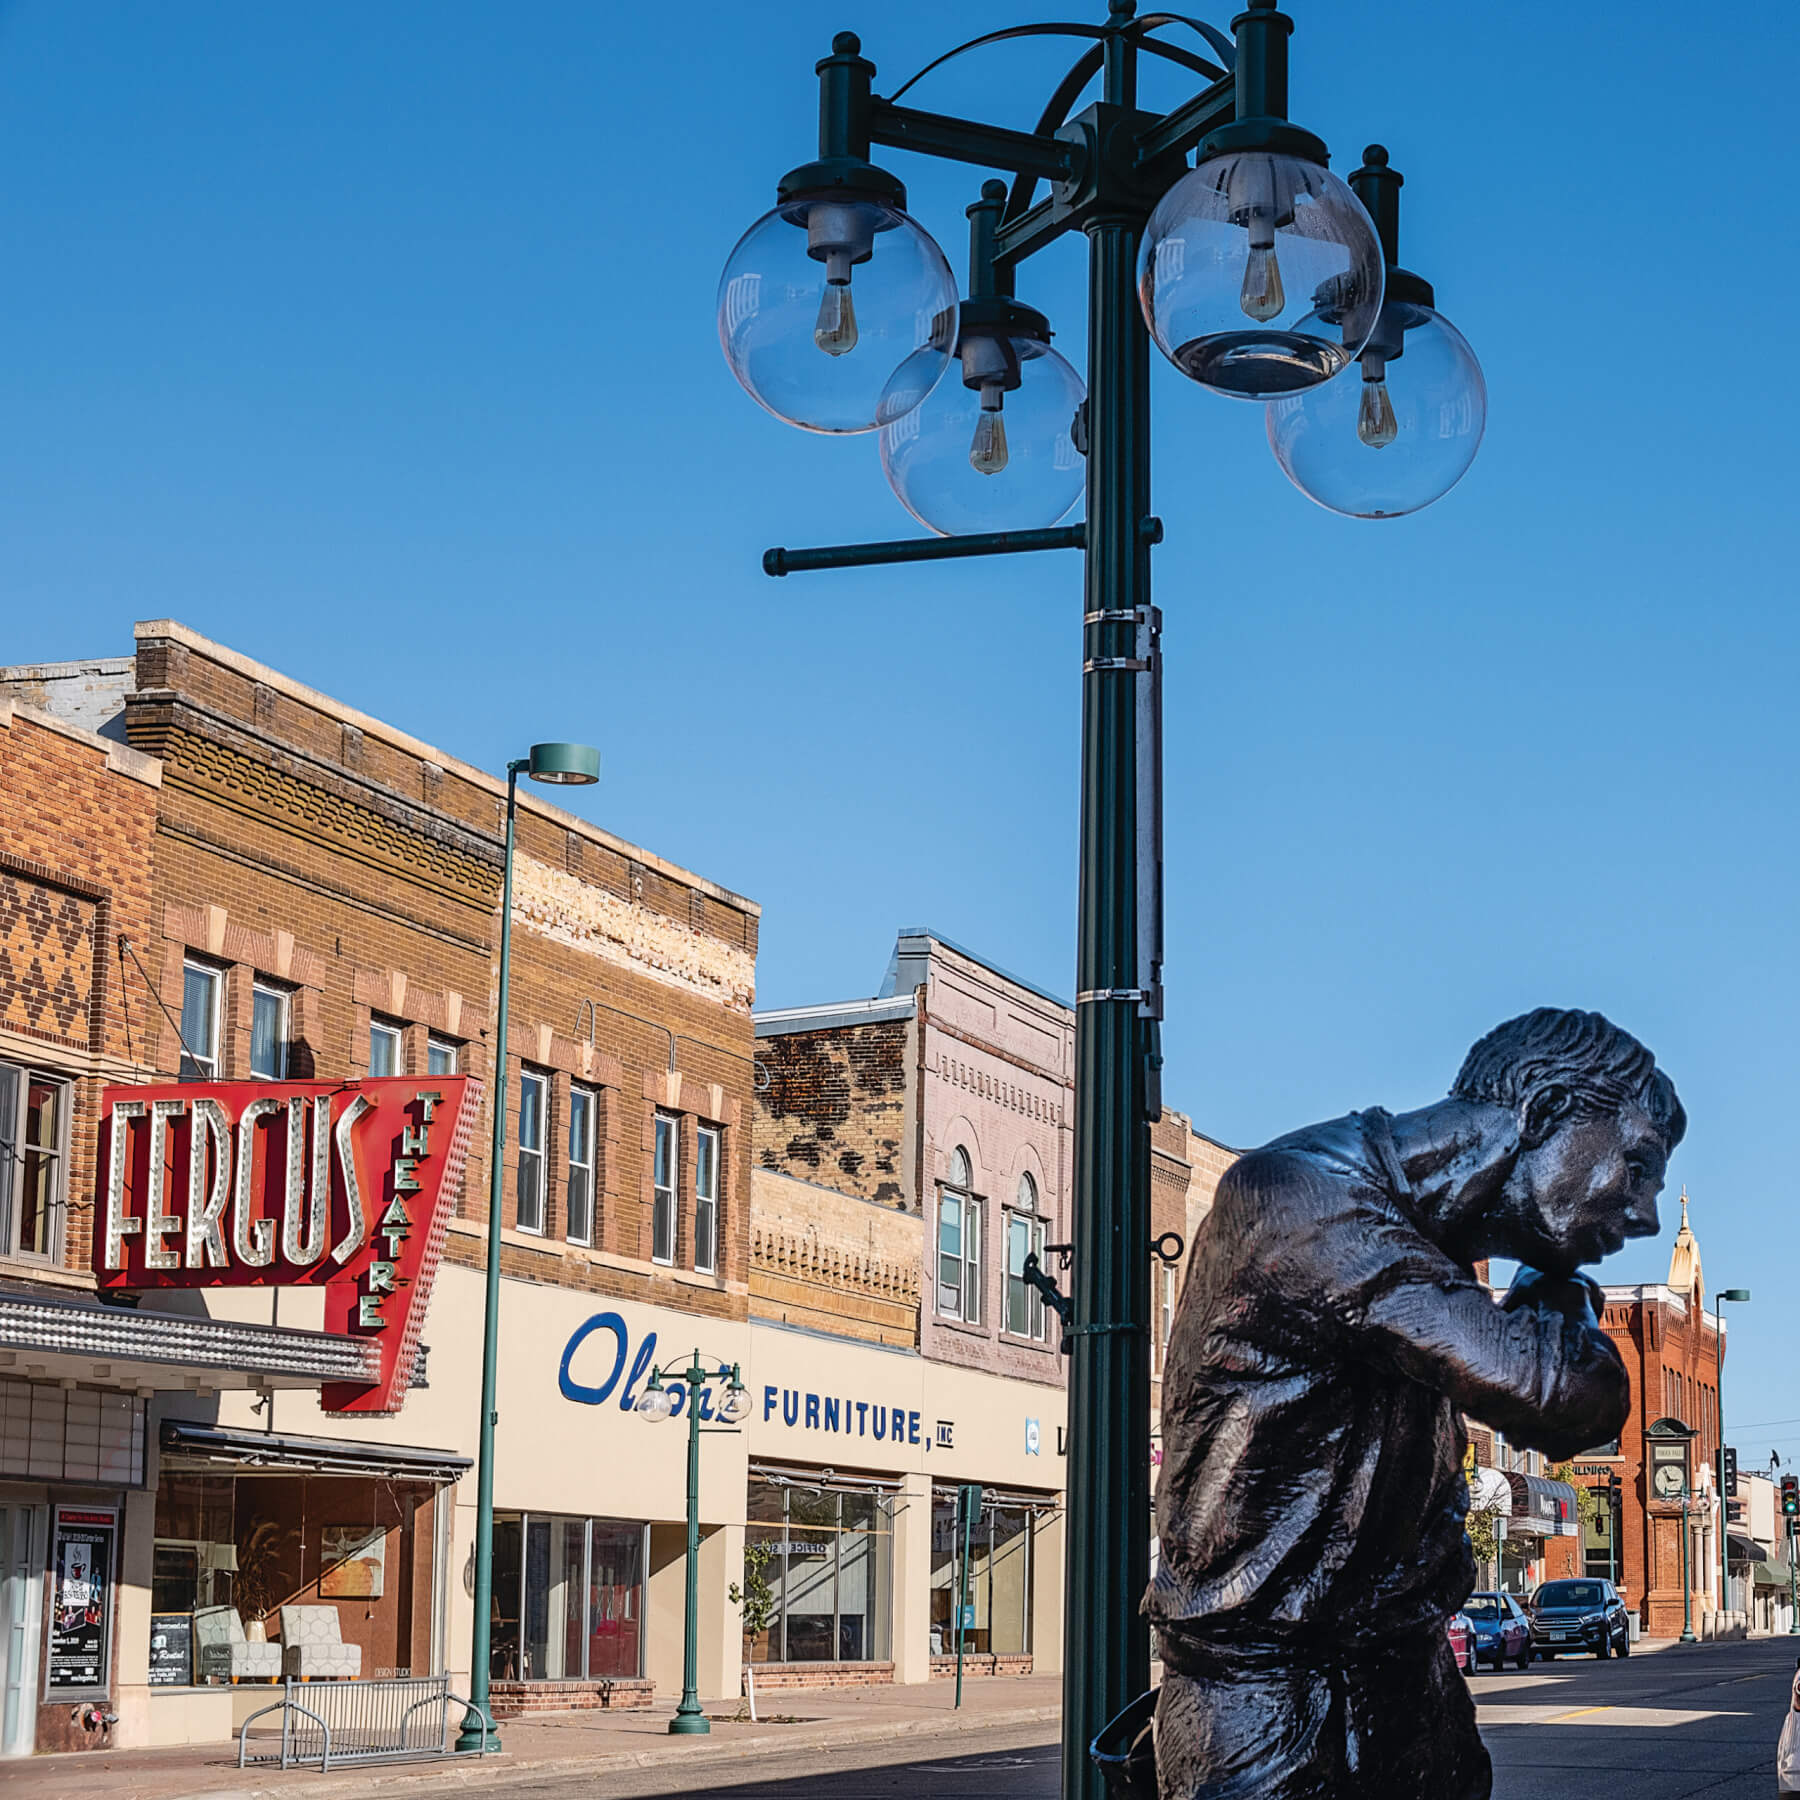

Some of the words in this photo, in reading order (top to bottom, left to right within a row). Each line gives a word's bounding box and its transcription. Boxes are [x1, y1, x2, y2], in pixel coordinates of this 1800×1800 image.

[105, 1094, 374, 1269] FERGUS
[360, 1091, 441, 1327] THEATRE
[763, 1385, 932, 1452] FURNITURE,
[936, 1425, 953, 1444] INC
